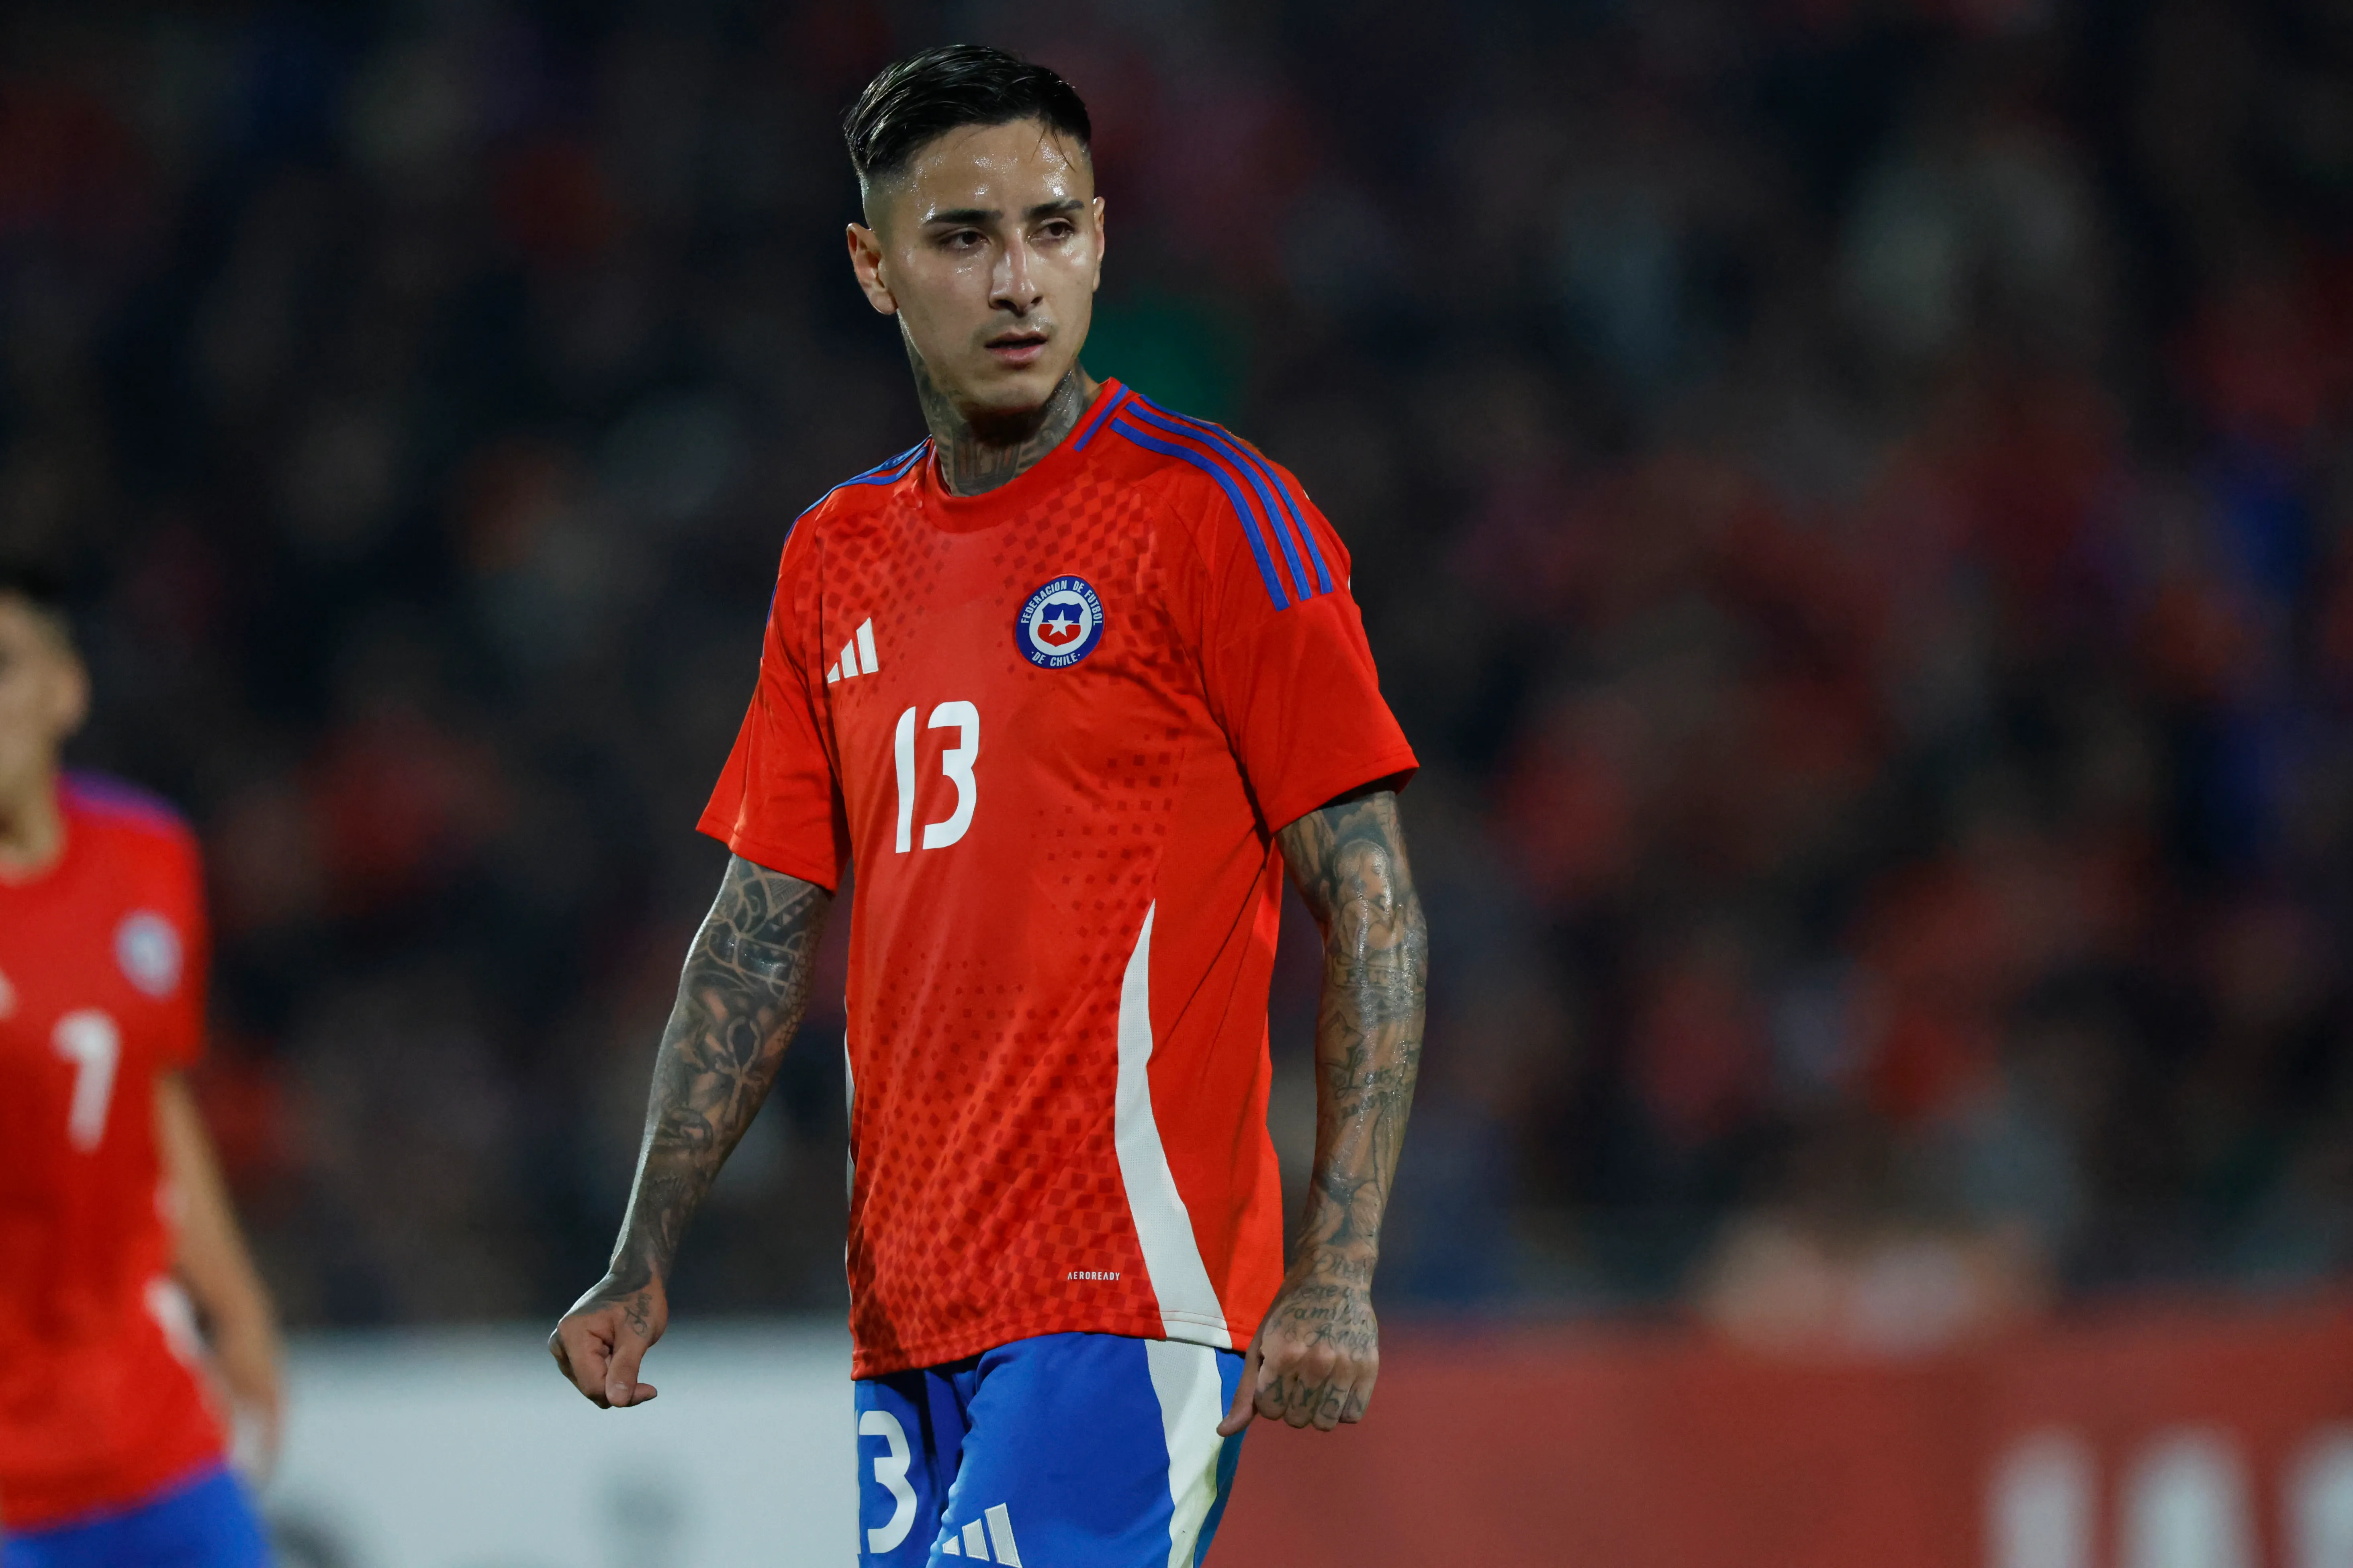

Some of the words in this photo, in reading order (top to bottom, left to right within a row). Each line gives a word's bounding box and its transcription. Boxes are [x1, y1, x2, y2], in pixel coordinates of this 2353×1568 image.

[1021, 580, 1067, 623] FEDERACION
[1073, 580, 1084, 593] DE
[1084, 590, 1102, 626] FUTBOL
[1032, 651, 1046, 664] DE
[1050, 652, 1078, 666] CHILE
[895, 701, 979, 853] 13
[1067, 1271, 1120, 1281] AEROREADY
